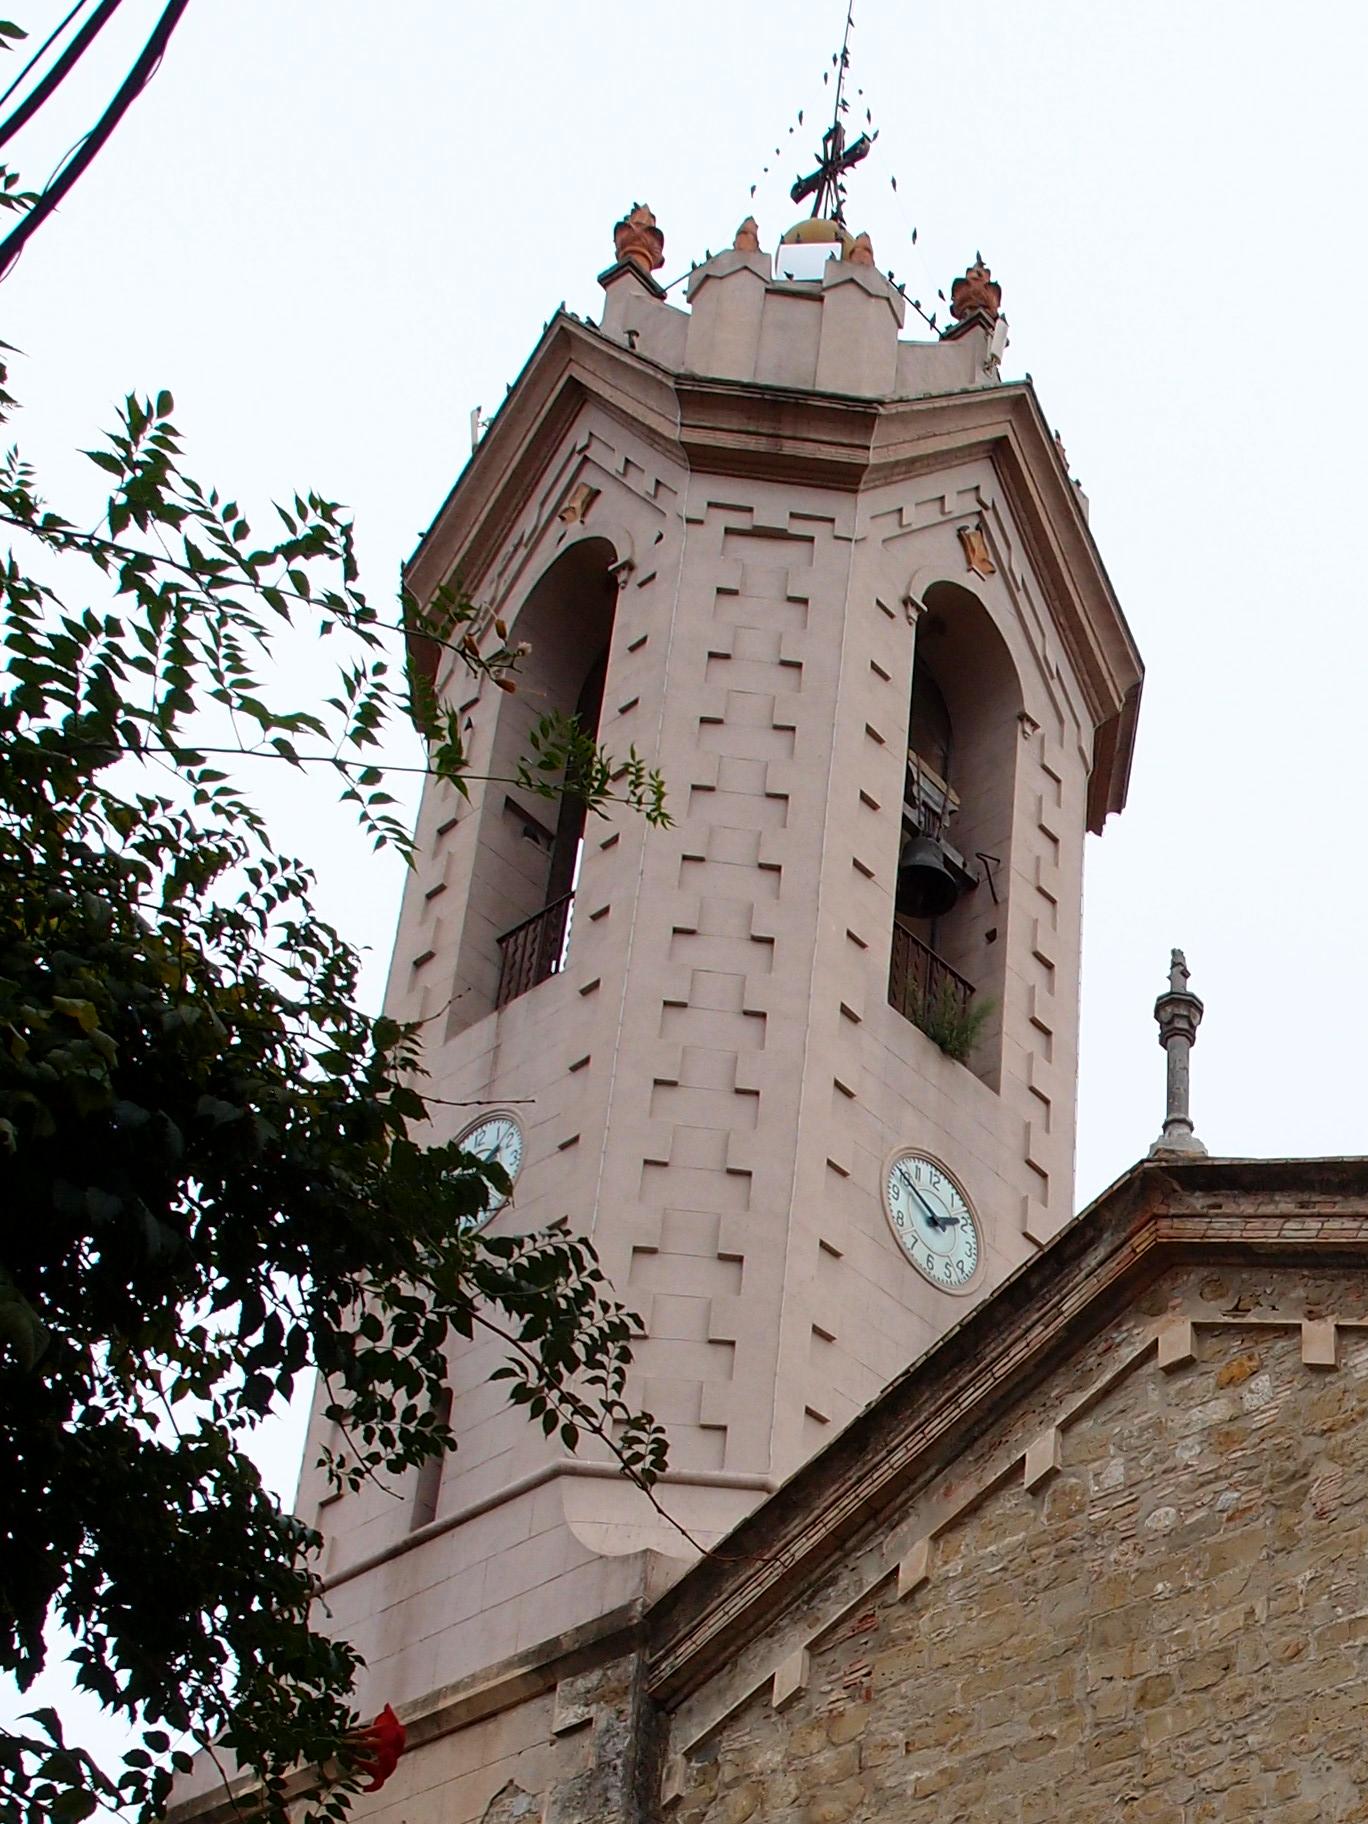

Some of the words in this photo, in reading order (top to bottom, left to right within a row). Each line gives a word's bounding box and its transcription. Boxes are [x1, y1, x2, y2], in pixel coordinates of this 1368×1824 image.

[474, 1130, 486, 1148] 12
[506, 1132, 514, 1149] 2
[509, 1149, 518, 1166] 3
[915, 1165, 921, 1182] 11
[929, 1170, 941, 1191] 12
[891, 1184, 900, 1201] 9
[896, 1210, 904, 1227] 8
[960, 1216, 968, 1233] 2
[911, 1234, 918, 1250] 7
[965, 1241, 973, 1257] 3
[926, 1254, 934, 1270] 6
[944, 1262, 952, 1279] 5
